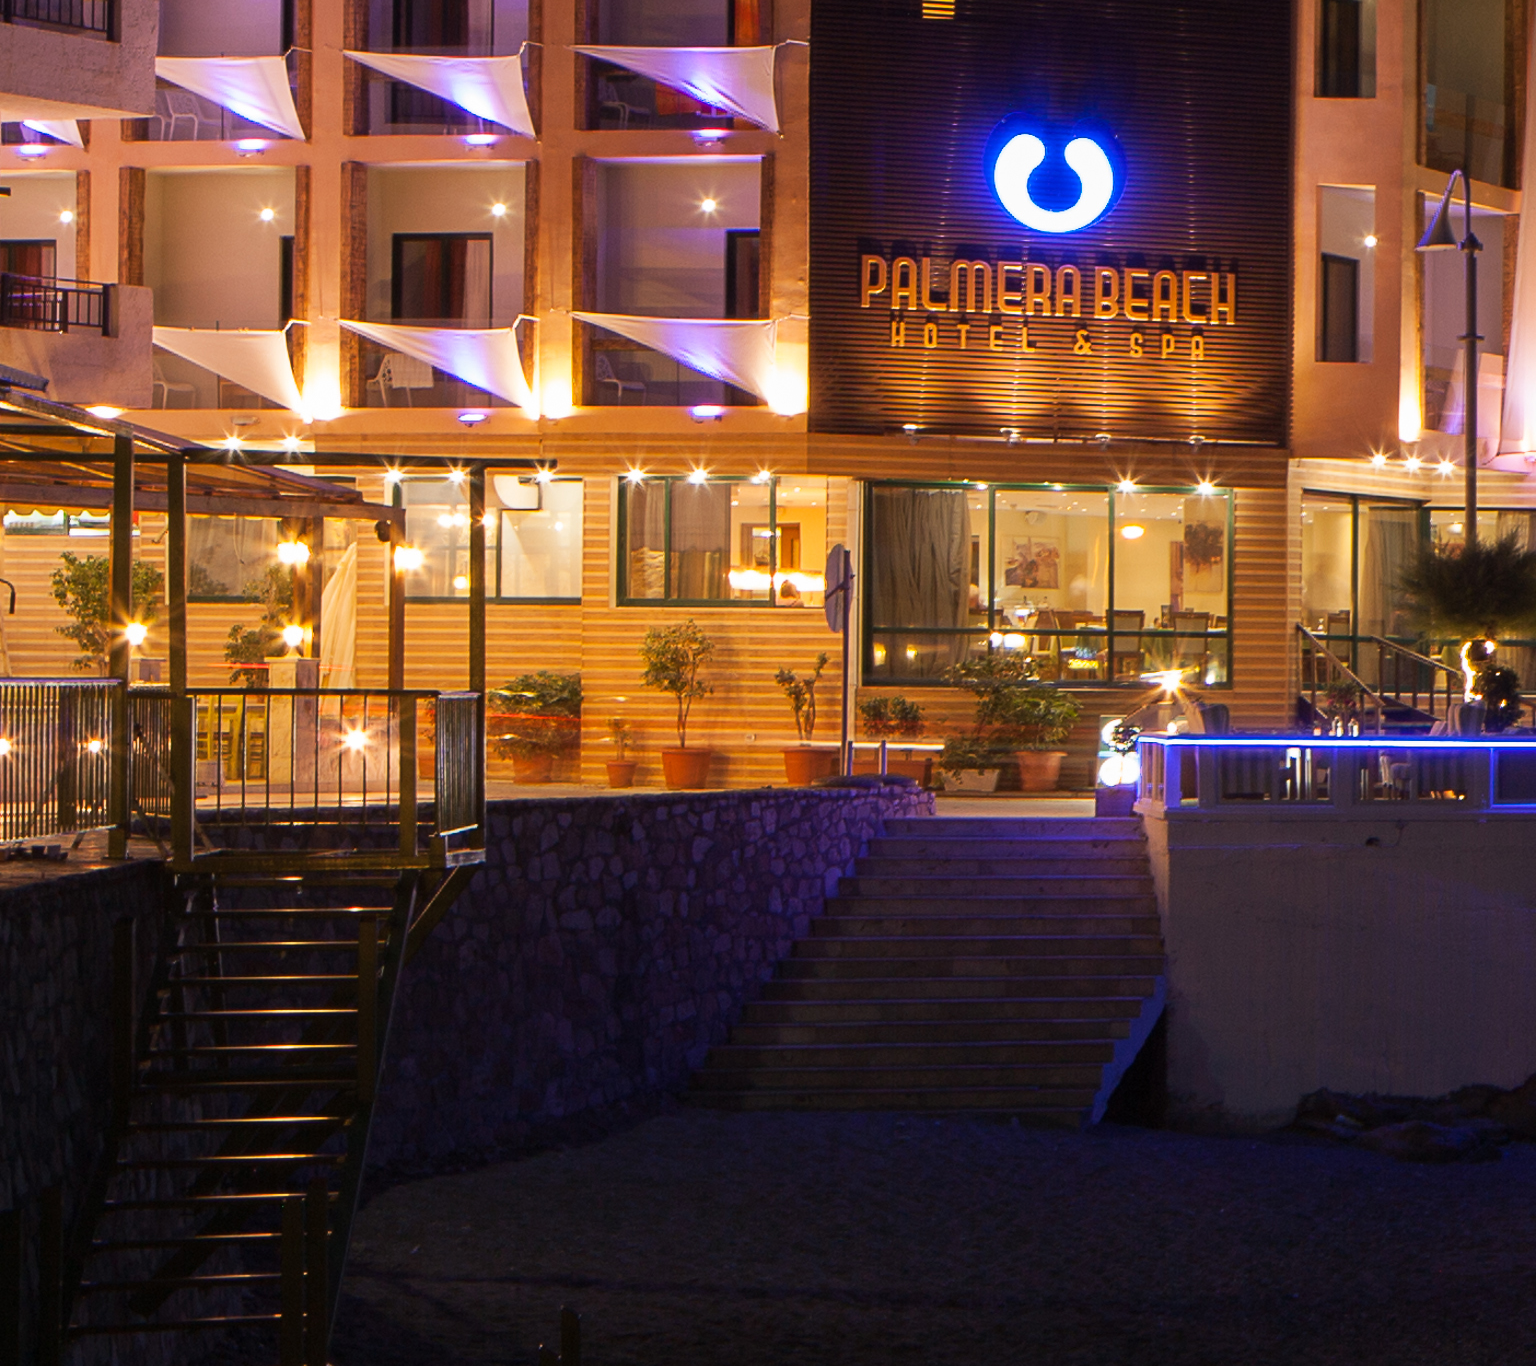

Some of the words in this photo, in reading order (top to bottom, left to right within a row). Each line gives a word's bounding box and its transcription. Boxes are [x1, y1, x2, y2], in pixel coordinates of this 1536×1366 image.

[861, 254, 1081, 317] PALMERA
[1094, 265, 1236, 325] BEACH
[890, 321, 1035, 353] HOTEL
[1074, 329, 1092, 355] &
[1129, 332, 1205, 360] SPA
